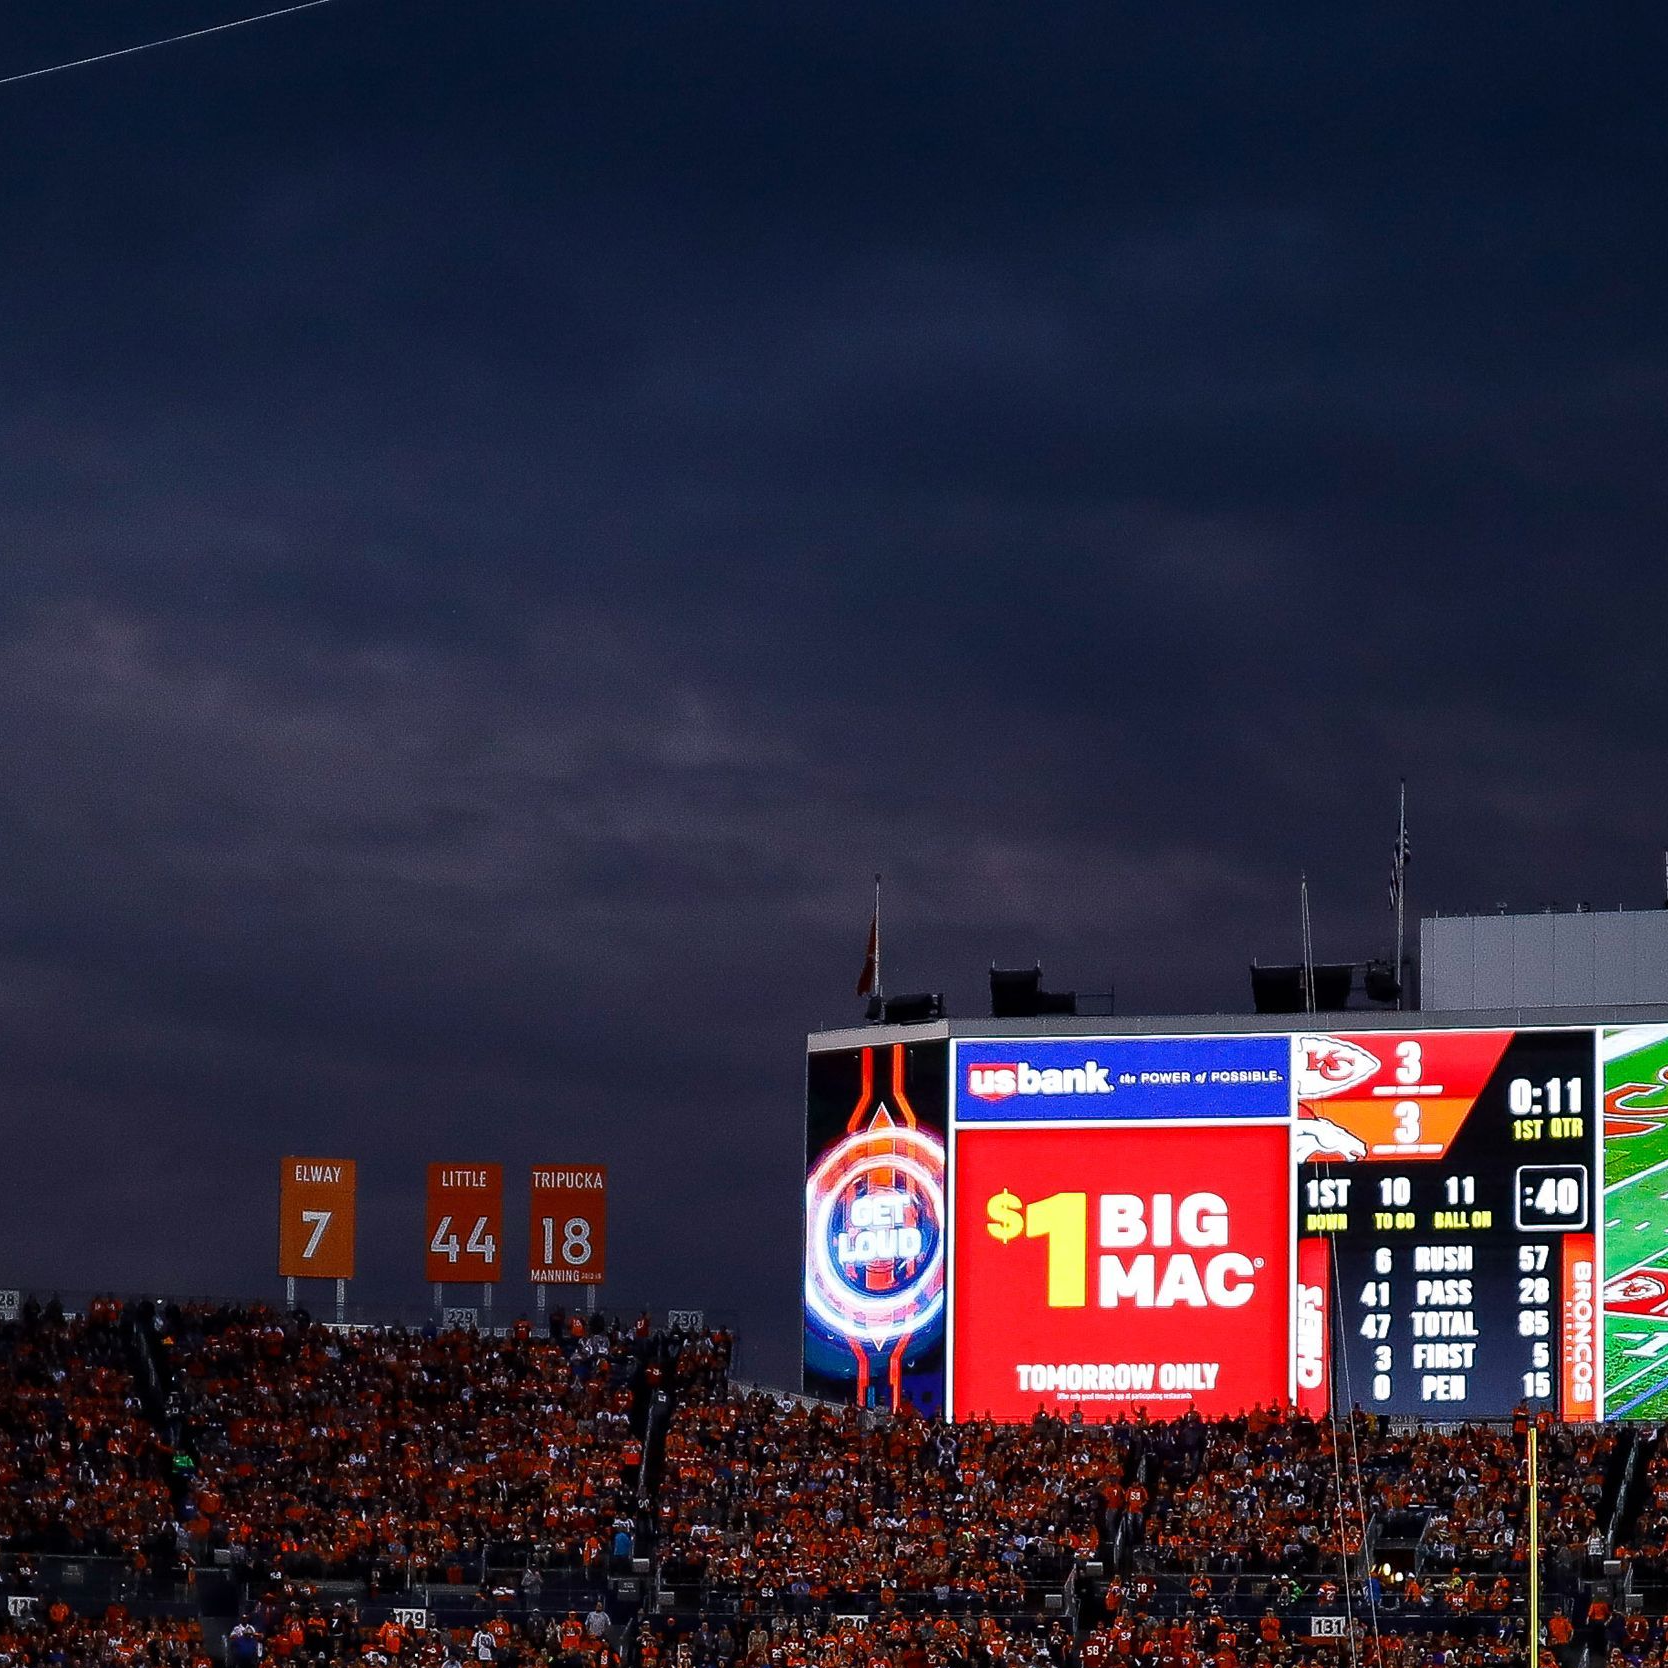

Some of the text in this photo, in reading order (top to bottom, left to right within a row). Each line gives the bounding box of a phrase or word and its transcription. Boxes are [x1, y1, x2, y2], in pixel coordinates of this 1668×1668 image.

[1395, 1040, 1423, 1084] 3
[1141, 1072, 1191, 1083] POWER
[1195, 1071, 1208, 1085] of
[1508, 1077, 1582, 1116] 0:11
[1393, 1100, 1422, 1144] 3
[1513, 1117, 1583, 1140] 1ST QTR
[295, 1165, 342, 1184] ELWAY
[442, 1170, 486, 1188] LITTLE
[533, 1171, 604, 1189] TRIPUCKA
[1306, 1178, 1351, 1208] 1ST
[1380, 1176, 1411, 1207] 10
[1445, 1175, 1475, 1205] 11
[850, 1194, 909, 1228] GET
[1306, 1210, 1492, 1232] DOWN TO GO BALL ON
[302, 1210, 332, 1259] 7
[430, 1216, 496, 1264] 44
[542, 1217, 592, 1265] 18
[838, 1228, 922, 1265] LOUD
[987, 1188, 1229, 1308] $1 BIG
[1375, 1245, 1549, 1274] 6 RUSH 57
[531, 1268, 580, 1283] MANNING
[1360, 1278, 1550, 1307] 41 PASS 28
[448, 1310, 474, 1325] 229
[1360, 1310, 1549, 1339] 47 TOTAL 85
[1573, 1261, 1594, 1402] BRONCOS
[1297, 1284, 1323, 1389] CHIEFS
[1374, 1342, 1549, 1371] 3 FIRST 5
[1016, 1362, 1220, 1392] TOMORROW ONLY
[1373, 1372, 1550, 1401] 0 PEN 15
[1315, 1619, 1341, 1636] 131
